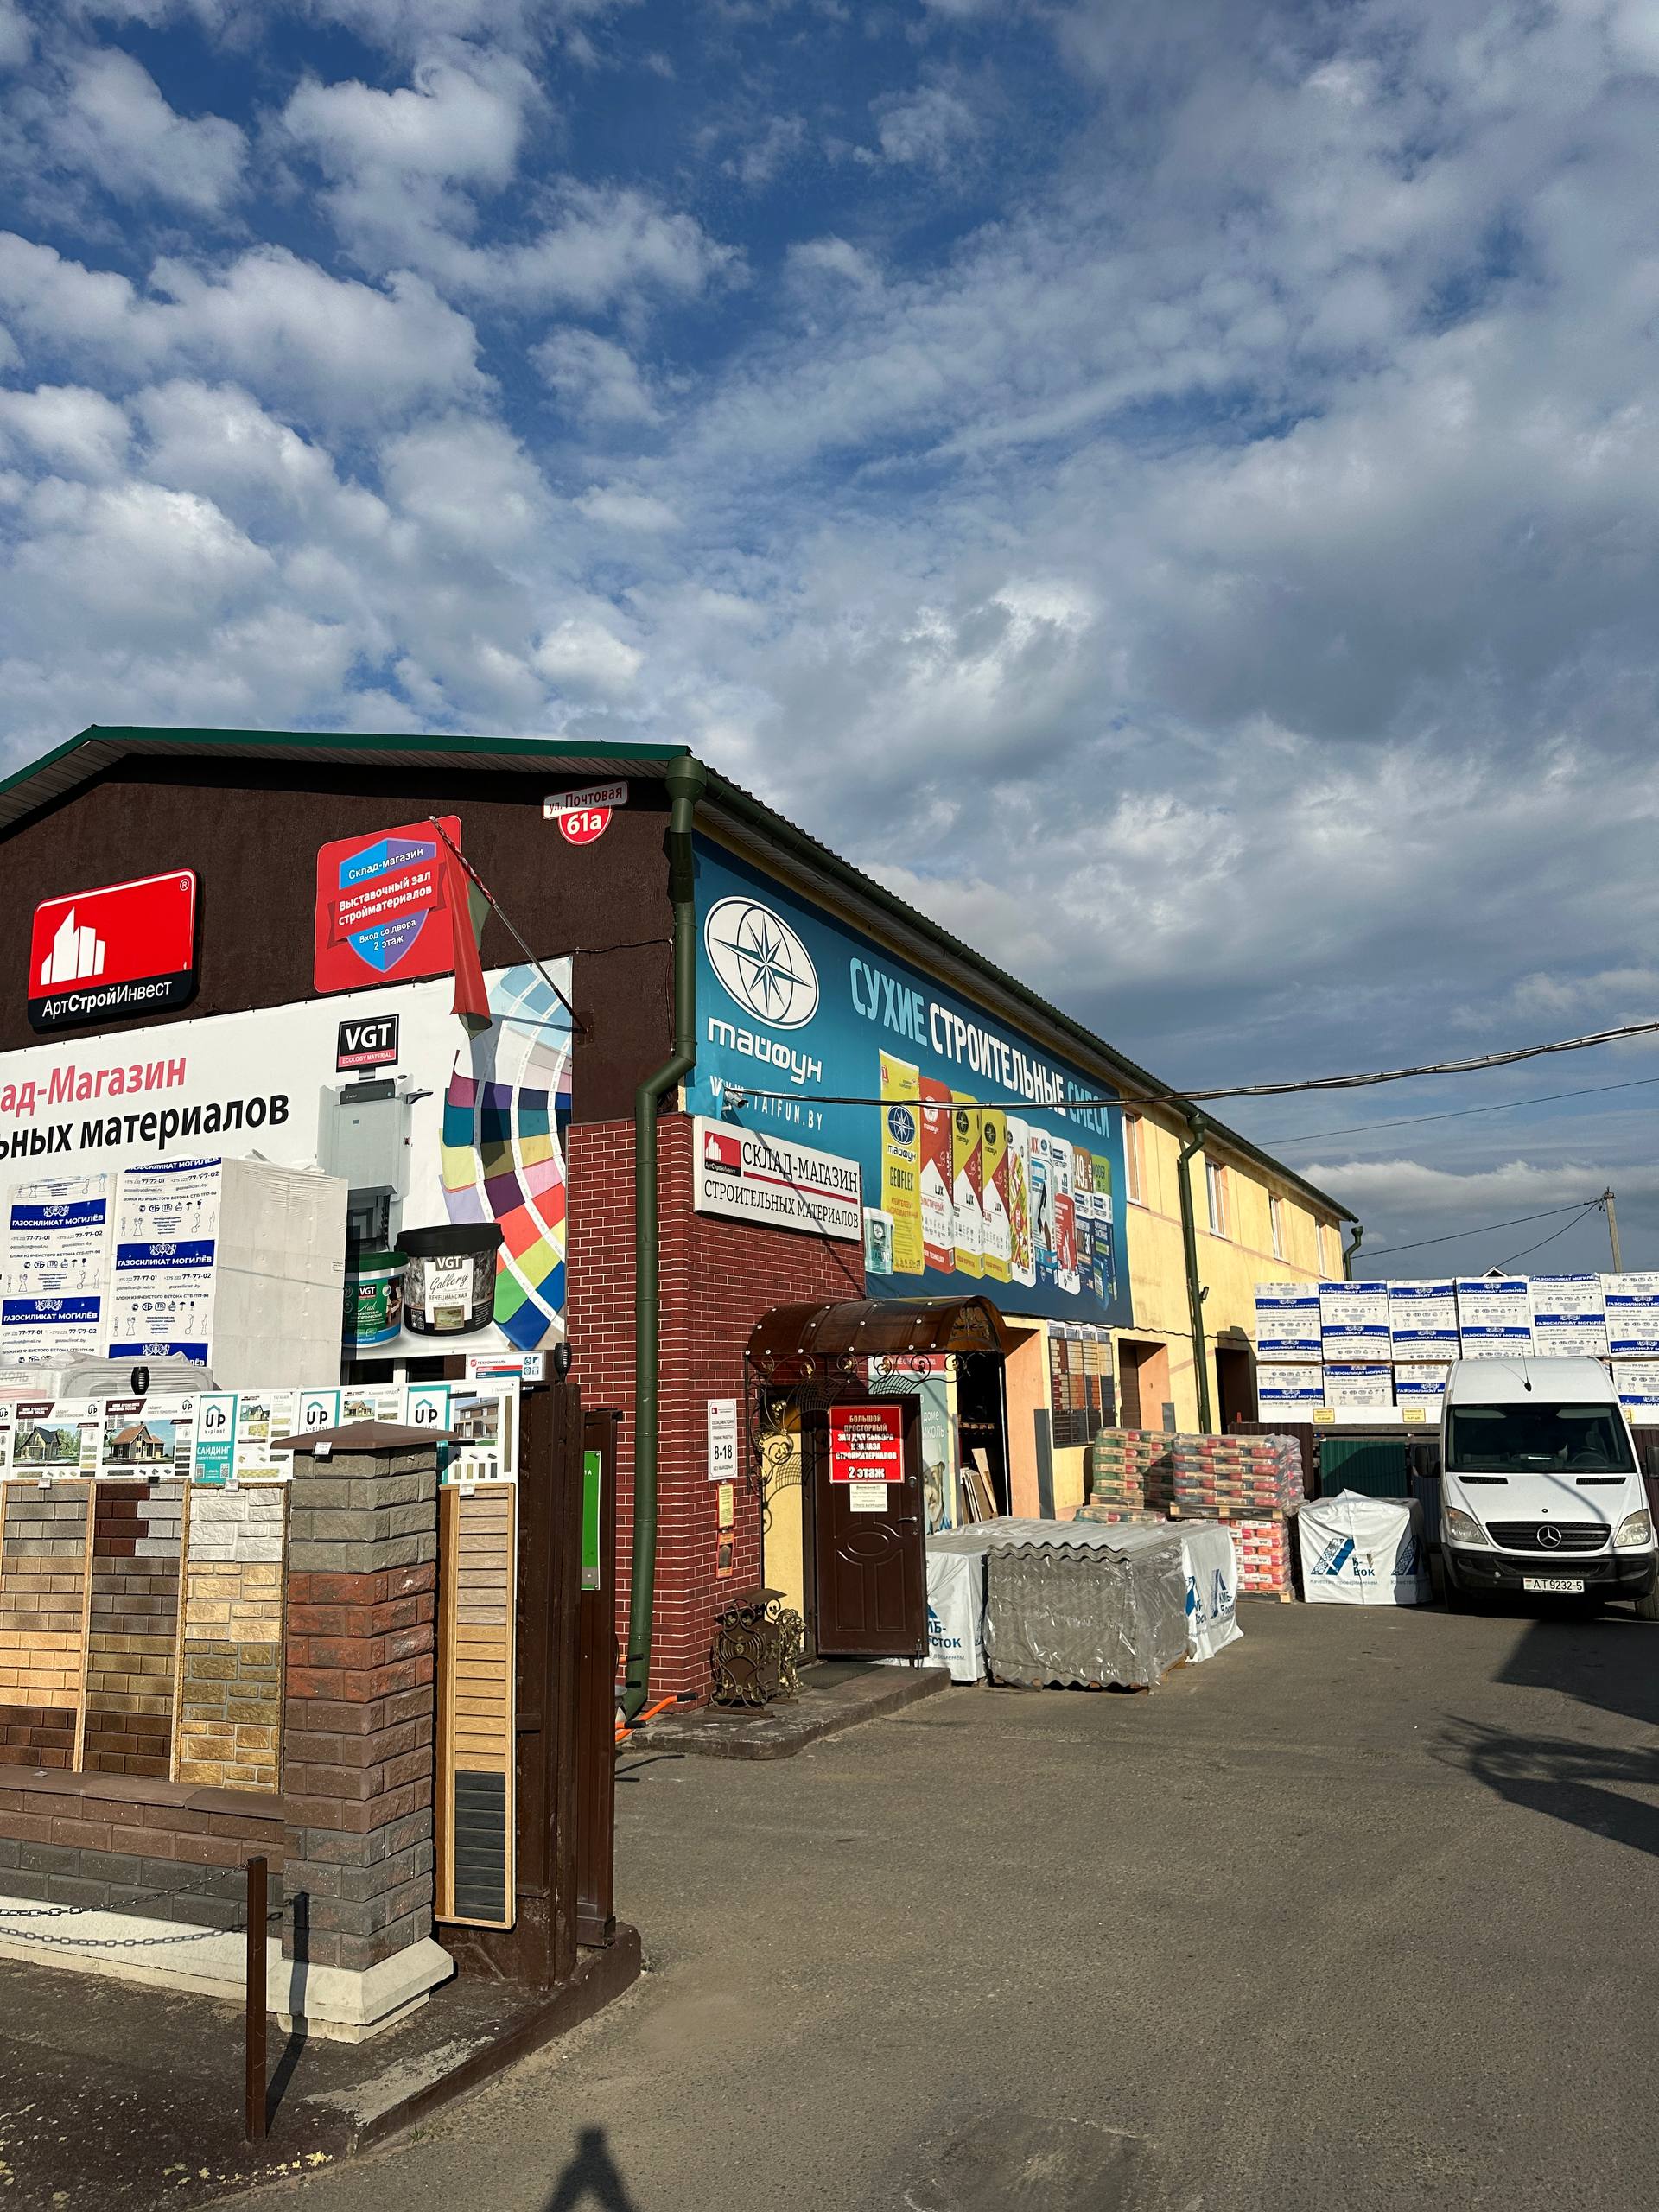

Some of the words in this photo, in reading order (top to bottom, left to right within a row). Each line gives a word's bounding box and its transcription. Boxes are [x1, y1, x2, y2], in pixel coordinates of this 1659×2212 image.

[549, 801, 563, 814] ул.
[565, 787, 622, 809] Почтовая
[567, 812, 602, 835] 61а
[348, 849, 423, 880] Склад-магазин
[339, 877, 410, 912] Выставочный
[411, 871, 431, 886] зал
[338, 885, 432, 925] стройматериалов
[359, 931, 379, 944] Вход
[380, 927, 390, 936] со
[391, 919, 416, 934] двора
[373, 941, 379, 951] 2
[382, 936, 404, 949] этаж
[42, 981, 172, 1019] АртСтройИнвест
[346, 1023, 391, 1051] VGT
[849, 957, 928, 1046] СУХИЕ
[929, 1002, 1066, 1117] СТРОИТЕЛЬНЫЕ
[1067, 1080, 1110, 1139] СМЕСИ
[342, 1056, 366, 1065] ECOLOGY
[367, 1052, 392, 1061] MATERIAL
[79, 1094, 289, 1150] материалов
[742, 1141, 858, 1193] СКЛАД-МАГАЗИН
[704, 1179, 795, 1216] СТРОИТЕЛЬНЫХ
[797, 1200, 859, 1229] МАТЕРИАЛОВ
[65, 1214, 104, 1225] МОГИЛЁВ
[118, 1258, 171, 1267] ГАЗОСИЛИКАТ
[172, 1255, 212, 1264] МОГИЛЁВ
[437, 1256, 461, 1269] VGT
[429, 1272, 469, 1291] Gallery
[359, 1287, 375, 1295] VGT
[429, 1293, 467, 1301] ВЕНЕЦИАНСКАЯ
[3, 1313, 56, 1322] ГАЗОСИЛИКАТ
[58, 1311, 98, 1319] МОГИЛЁВ
[206, 1414, 226, 1427] UP
[307, 1411, 328, 1425] UP
[416, 1409, 438, 1424] UP
[844, 1423, 887, 1432] ПРОСТОРНЫЙ
[197, 1445, 231, 1456] САЙДИНГ
[714, 1445, 733, 1460] 8-18
[836, 1451, 898, 1460] СТРОЙМАТЕРИАЛОВ
[848, 1466, 855, 1478] 2
[856, 1468, 885, 1478] этаж
[1549, 1581, 1582, 1591] 9232-5
